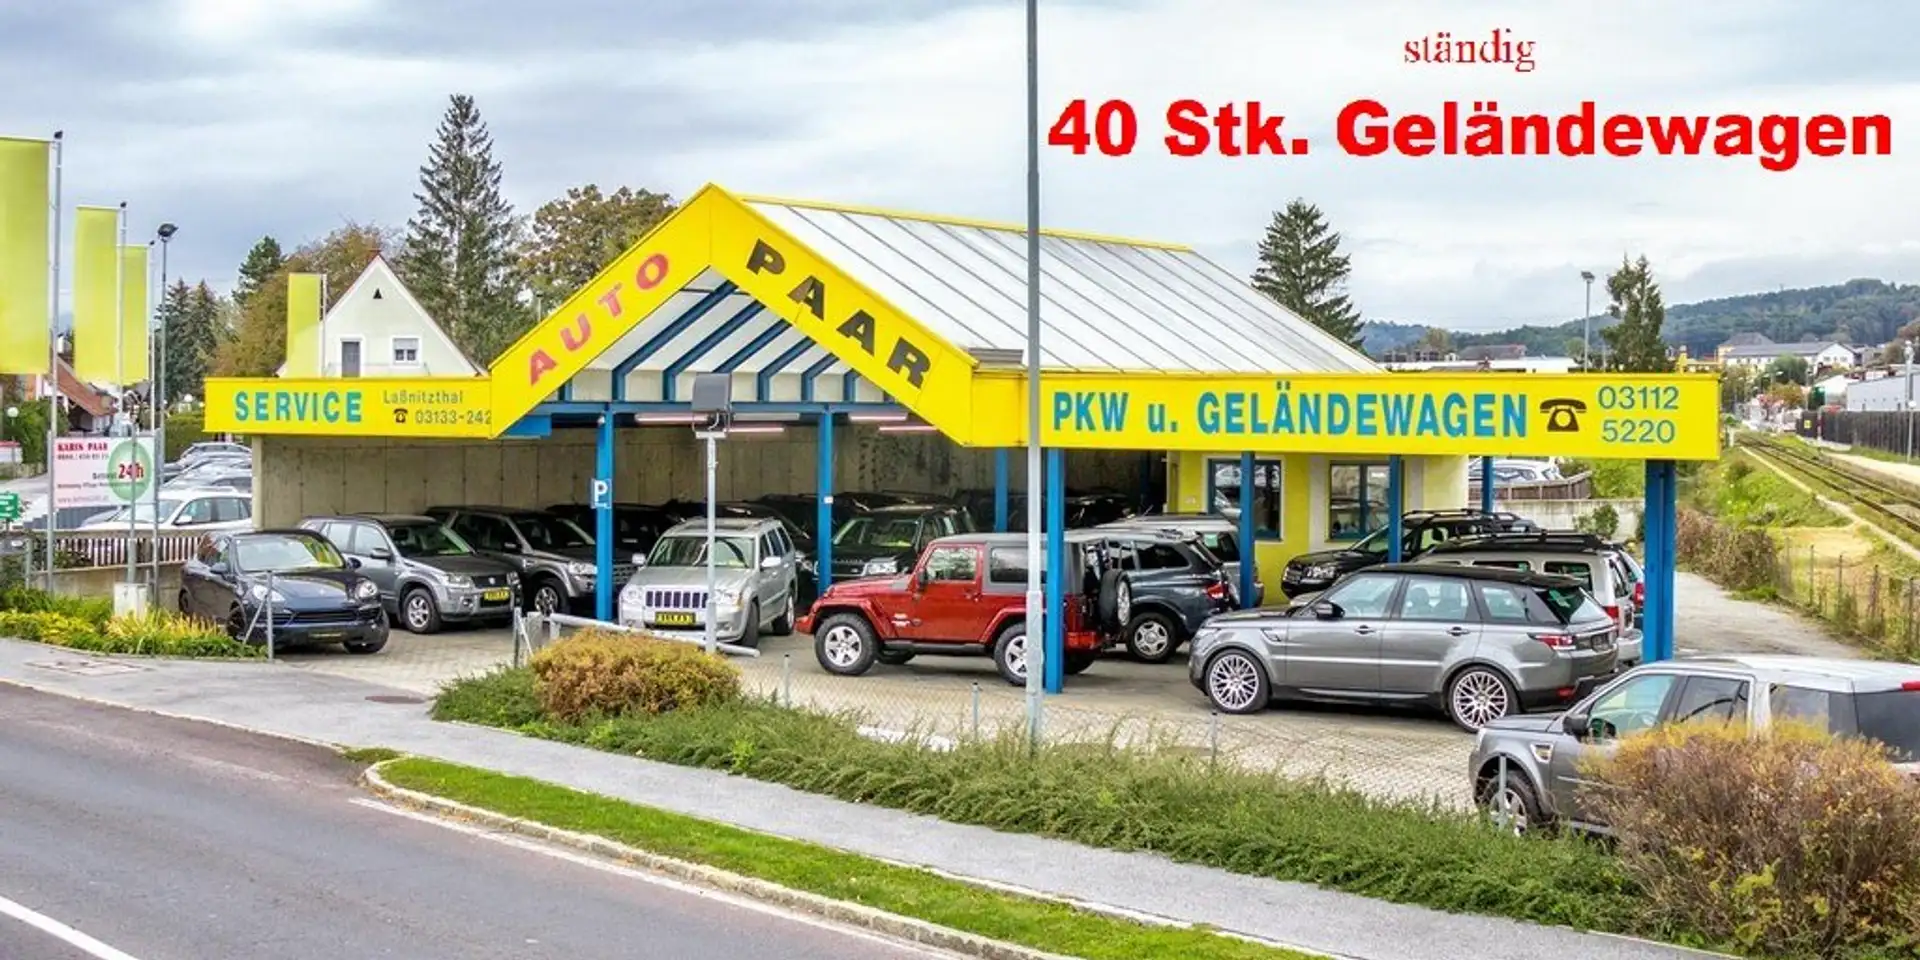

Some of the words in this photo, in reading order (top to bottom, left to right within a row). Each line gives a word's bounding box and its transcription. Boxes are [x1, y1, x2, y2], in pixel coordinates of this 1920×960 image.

[530, 253, 670, 386] AUTO
[746, 238, 932, 390] PAAR
[234, 391, 363, 424] SERVICE
[384, 389, 464, 405] Laßnitzthal
[1053, 391, 1129, 432] PKW
[1148, 403, 1178, 433] u.
[1197, 381, 1528, 438] GELÄNDEWAGEN
[1597, 385, 1680, 411] 03112
[1602, 418, 1677, 444] 5220
[594, 480, 609, 502] P
